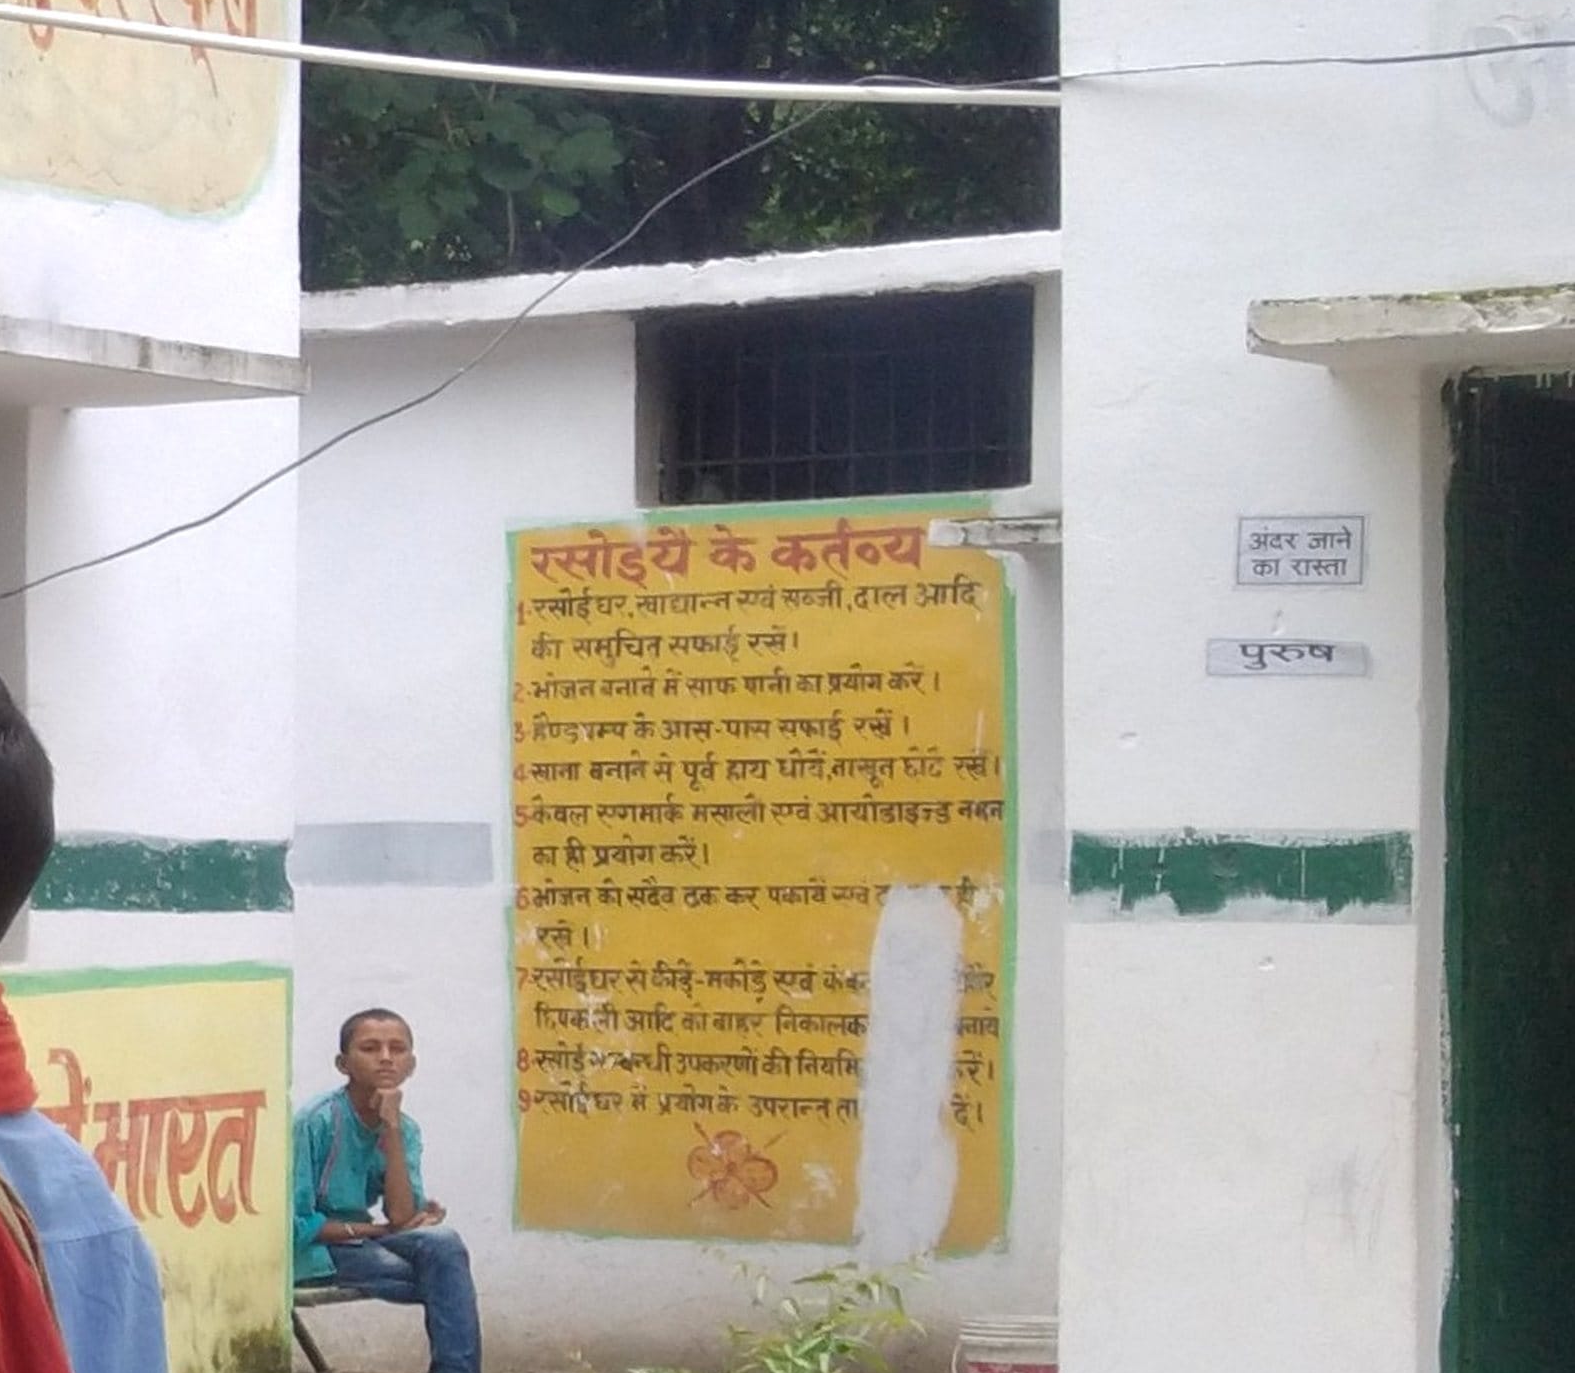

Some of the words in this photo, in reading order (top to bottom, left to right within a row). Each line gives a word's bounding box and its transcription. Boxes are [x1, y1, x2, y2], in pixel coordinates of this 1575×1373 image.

[709, 523, 758, 573] के
[770, 517, 925, 581] कर्तव्य
[1248, 525, 1300, 551] अंदर
[1306, 525, 1352, 551] जाने
[1251, 557, 1282, 578] का
[1290, 556, 1349, 578] रास्ता
[1238, 642, 1337, 672] पुरुष
